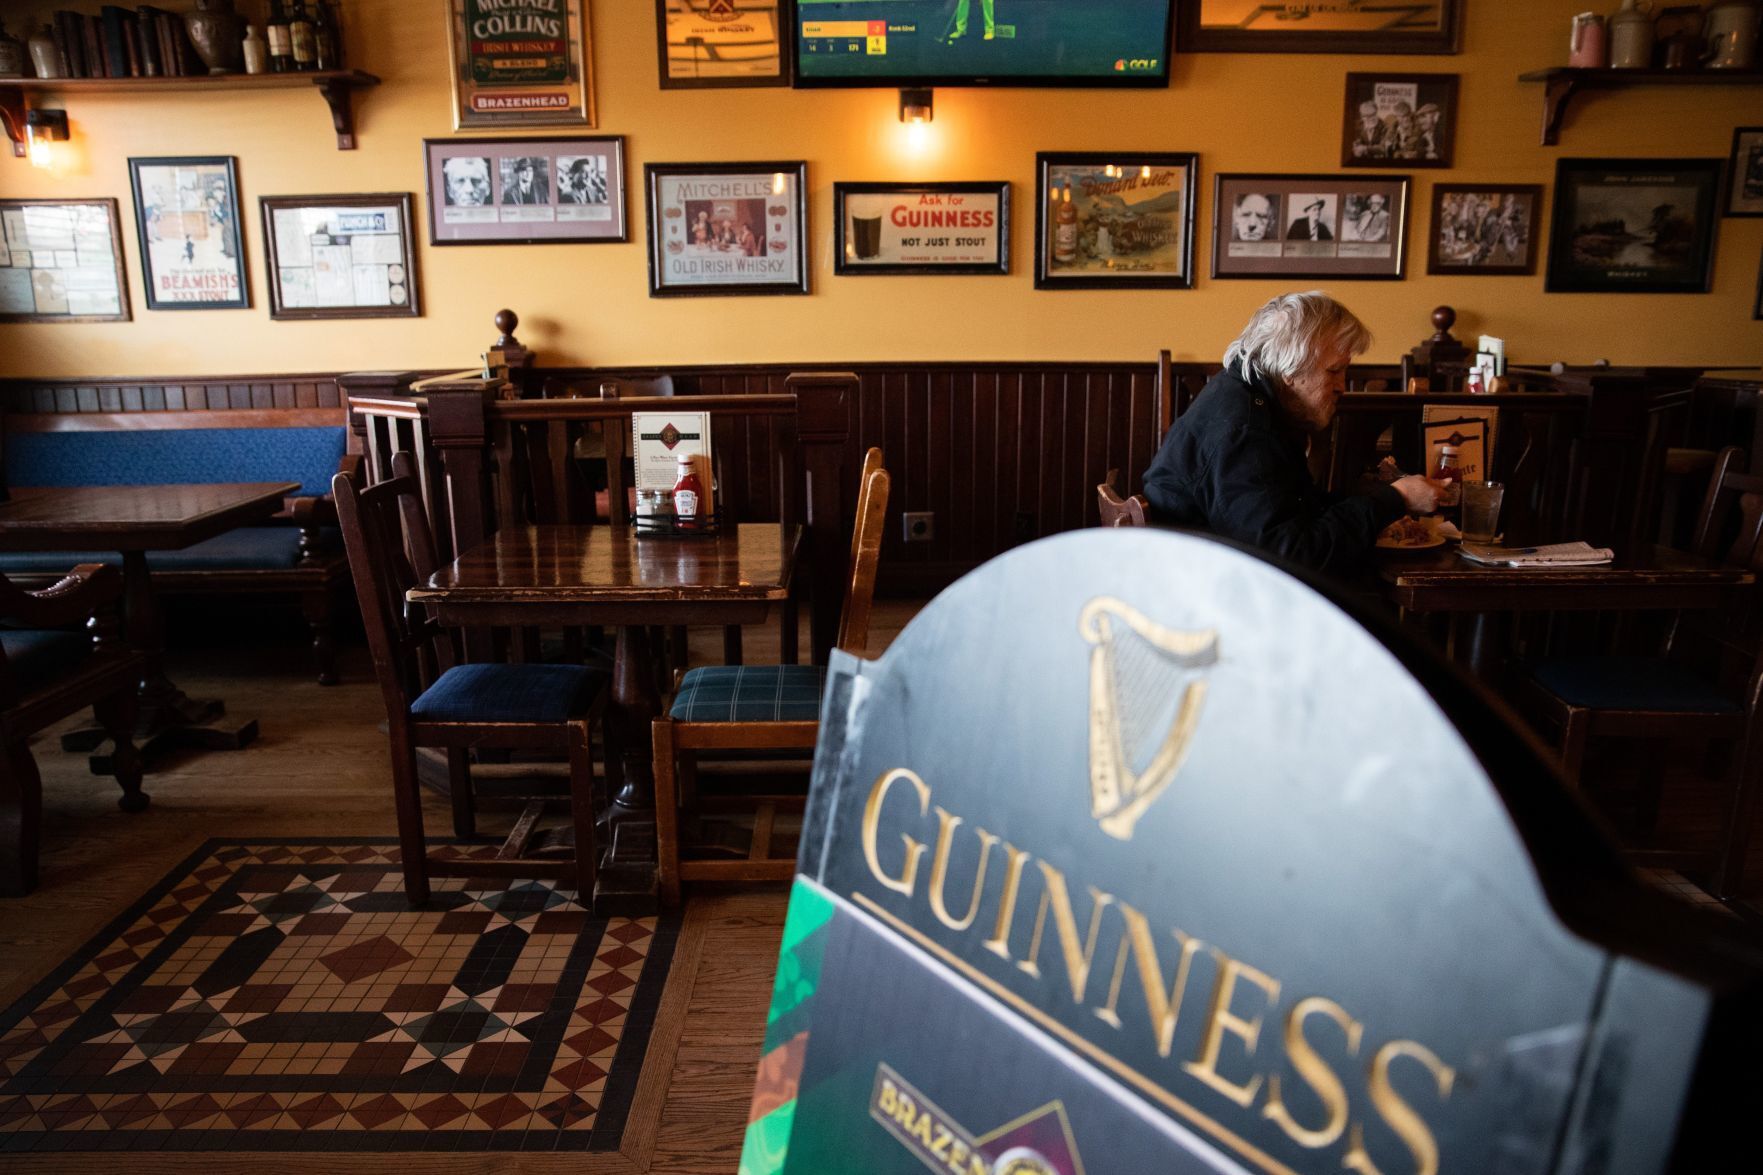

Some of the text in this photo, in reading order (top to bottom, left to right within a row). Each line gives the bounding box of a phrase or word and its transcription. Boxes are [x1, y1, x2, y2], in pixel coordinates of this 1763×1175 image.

[473, 14, 560, 38] COLLINS
[482, 41, 556, 53] IRISH WHISKEY
[1130, 59, 1157, 70] GOLF
[477, 96, 568, 109] BRAZENHEAD
[676, 182, 772, 204] MITCHELL'S
[919, 194, 964, 206] Ask for
[891, 205, 994, 228] GUINNESS
[902, 237, 986, 247] NOT JUST STOUT
[672, 259, 698, 274] OLD
[701, 258, 733, 273] IRISH
[862, 768, 1457, 1175] GUINNESS
